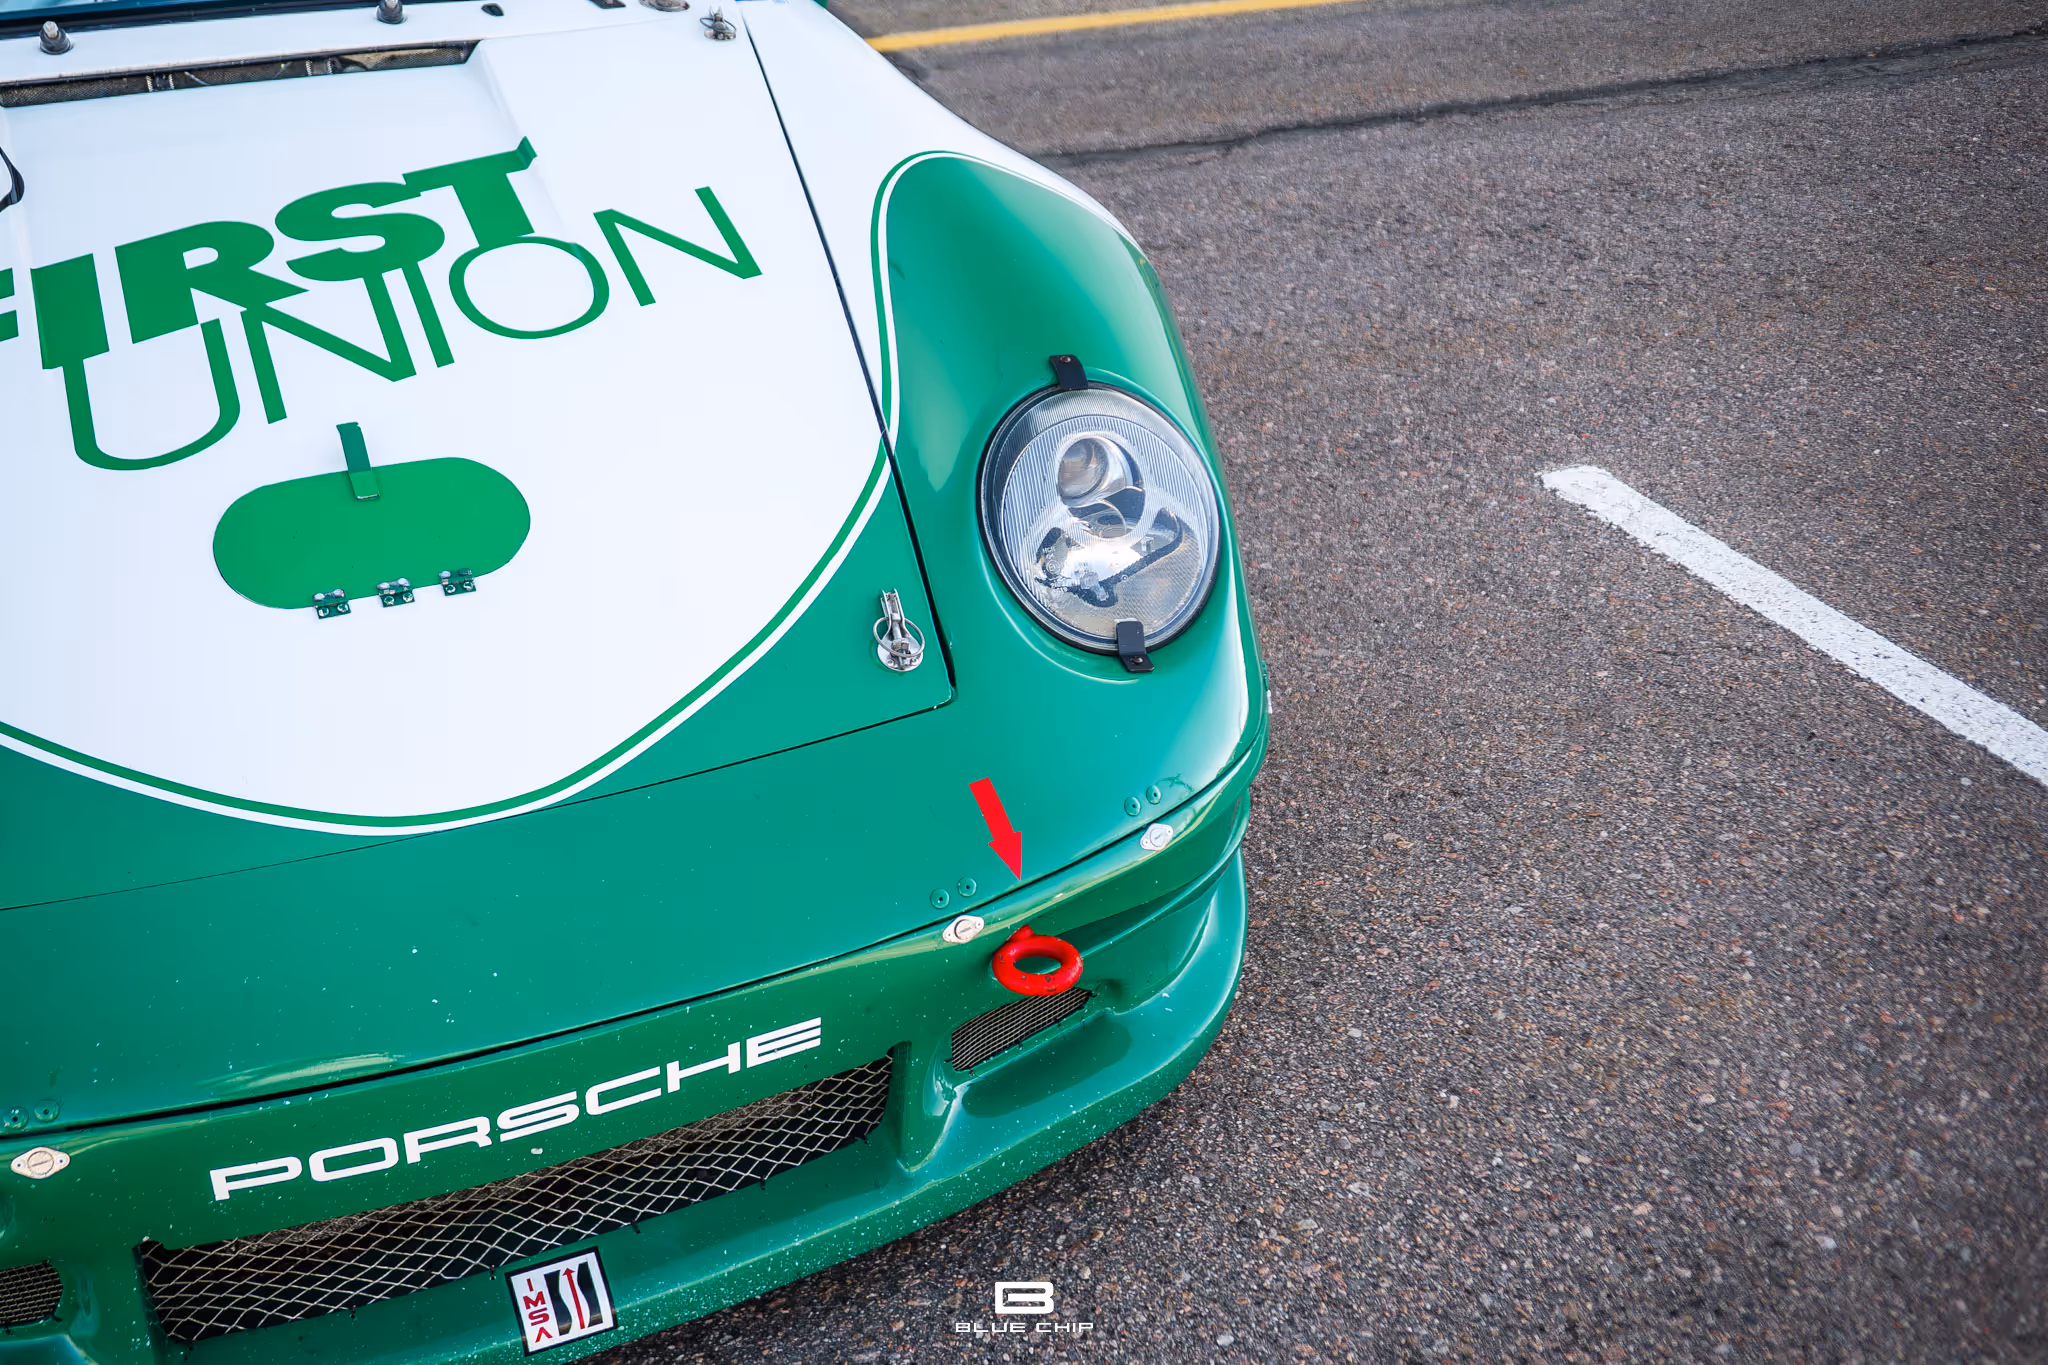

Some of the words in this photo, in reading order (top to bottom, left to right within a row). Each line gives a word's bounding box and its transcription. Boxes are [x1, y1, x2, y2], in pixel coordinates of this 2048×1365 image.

[62, 186, 763, 470] UNION
[210, 1017, 821, 1201] PORSCHE
[523, 1278, 553, 1343] IMSA
